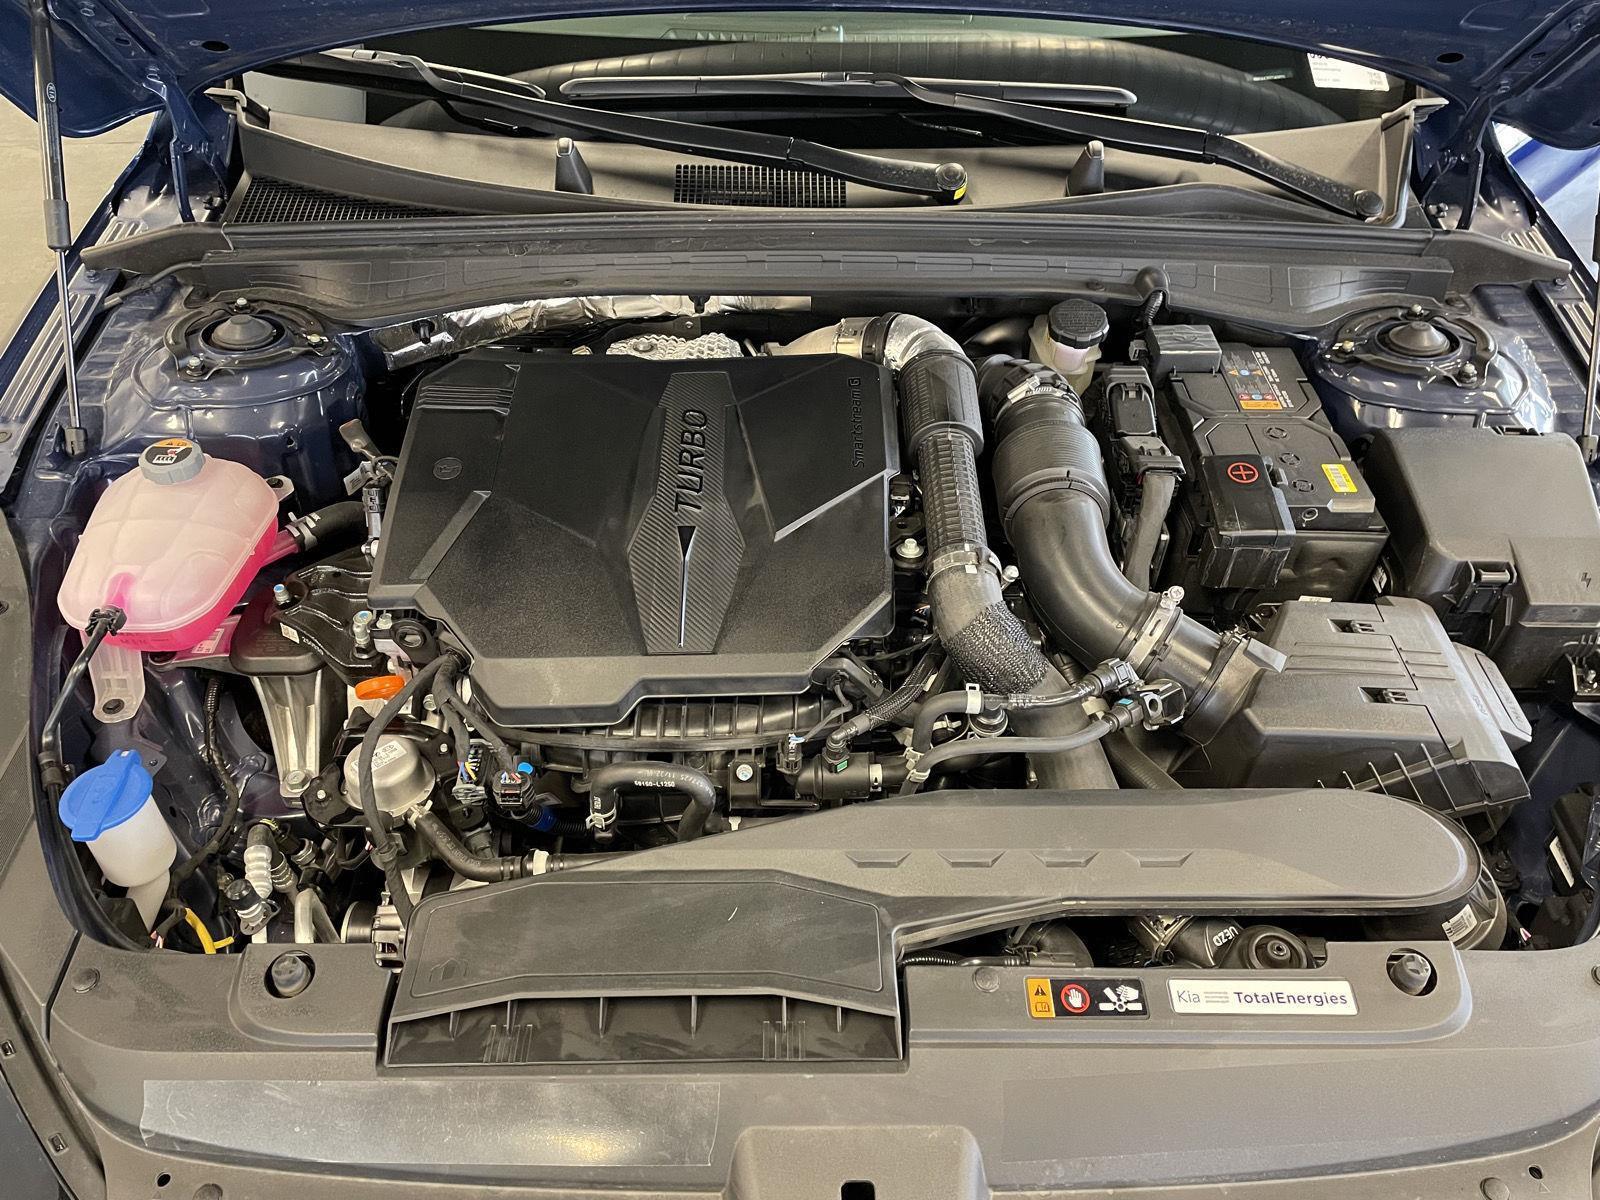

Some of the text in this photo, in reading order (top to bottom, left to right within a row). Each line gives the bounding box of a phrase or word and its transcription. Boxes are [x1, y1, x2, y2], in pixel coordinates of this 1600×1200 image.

[674, 408, 708, 513] TURBO
[851, 389, 865, 468] Smartstream
[1177, 990, 1201, 1004] Kia
[1233, 991, 1348, 1007] TotalEnergies
